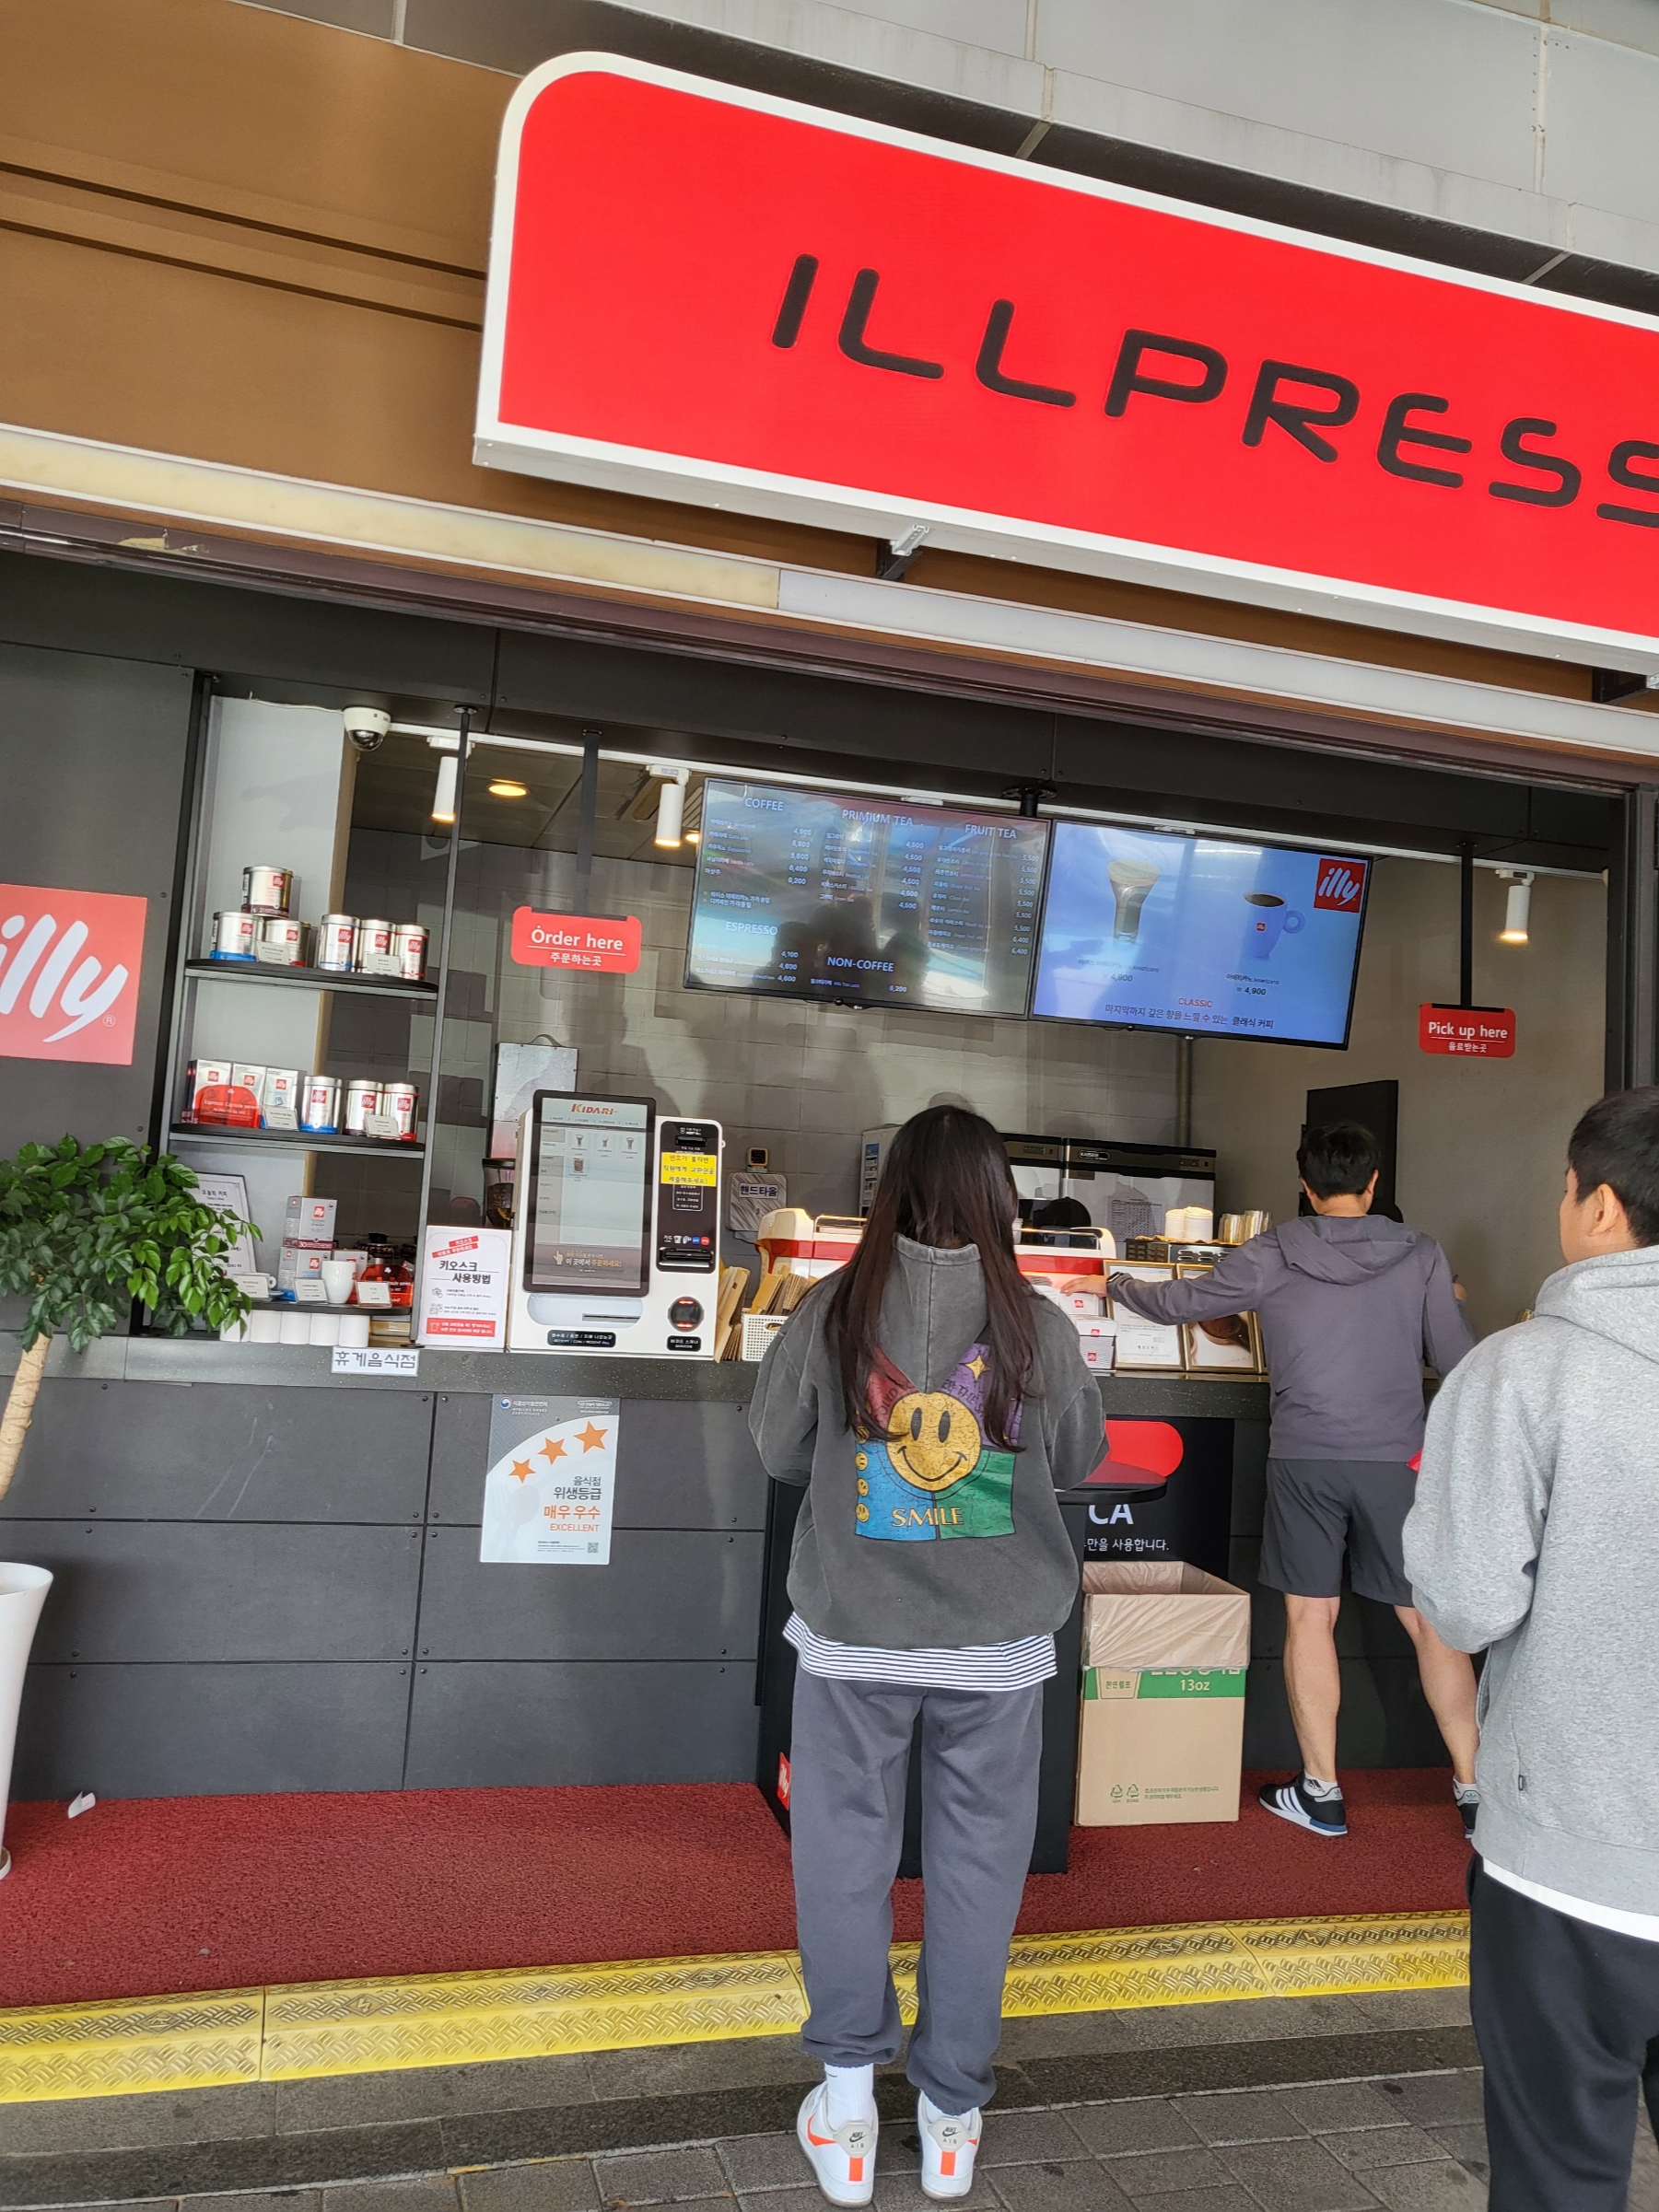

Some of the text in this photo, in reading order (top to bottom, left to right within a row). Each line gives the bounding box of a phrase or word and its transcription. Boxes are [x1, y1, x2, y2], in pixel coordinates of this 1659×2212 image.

[769, 252, 1659, 530] ILLPRESS
[745, 797, 784, 810] COFFEE
[842, 809, 913, 825] PRIMIUM TEA
[965, 824, 1017, 839] FRUIT TEA
[1318, 867, 1360, 906] illy
[726, 921, 777, 935] ESPRESSO
[339, 931, 351, 942] illy
[375, 936, 388, 947] illy
[532, 928, 624, 950] Order here
[409, 941, 420, 952] illy
[551, 952, 602, 966] 주문하는곳
[827, 956, 894, 972] NON-COFFEE
[0, 914, 128, 1042] illy
[1244, 987, 1267, 995] 4,900
[1178, 998, 1212, 1007] CLASSIC
[1104, 1004, 1274, 1030] 마지막까지 깊은 향을 느낄 수 있는 클래식 커피
[1428, 1022, 1508, 1039] Pick up here
[1448, 1042, 1487, 1053] 음료받는곳
[362, 1096, 375, 1107] illy
[398, 1100, 410, 1110] illy
[741, 1184, 777, 1197] 핸드타올
[438, 1260, 477, 1271] 키오스크
[452, 1274, 491, 1284] 사용방법
[334, 1352, 416, 1369] 휴게음식점
[574, 1476, 601, 1486] 음식점
[554, 1487, 602, 1500] 위생등급
[543, 1506, 600, 1519] 매우 우수
[891, 1508, 964, 1526] SMILE
[1113, 1539, 1169, 1552] 사용합니다.
[1180, 1680, 1209, 1691] 13oz
